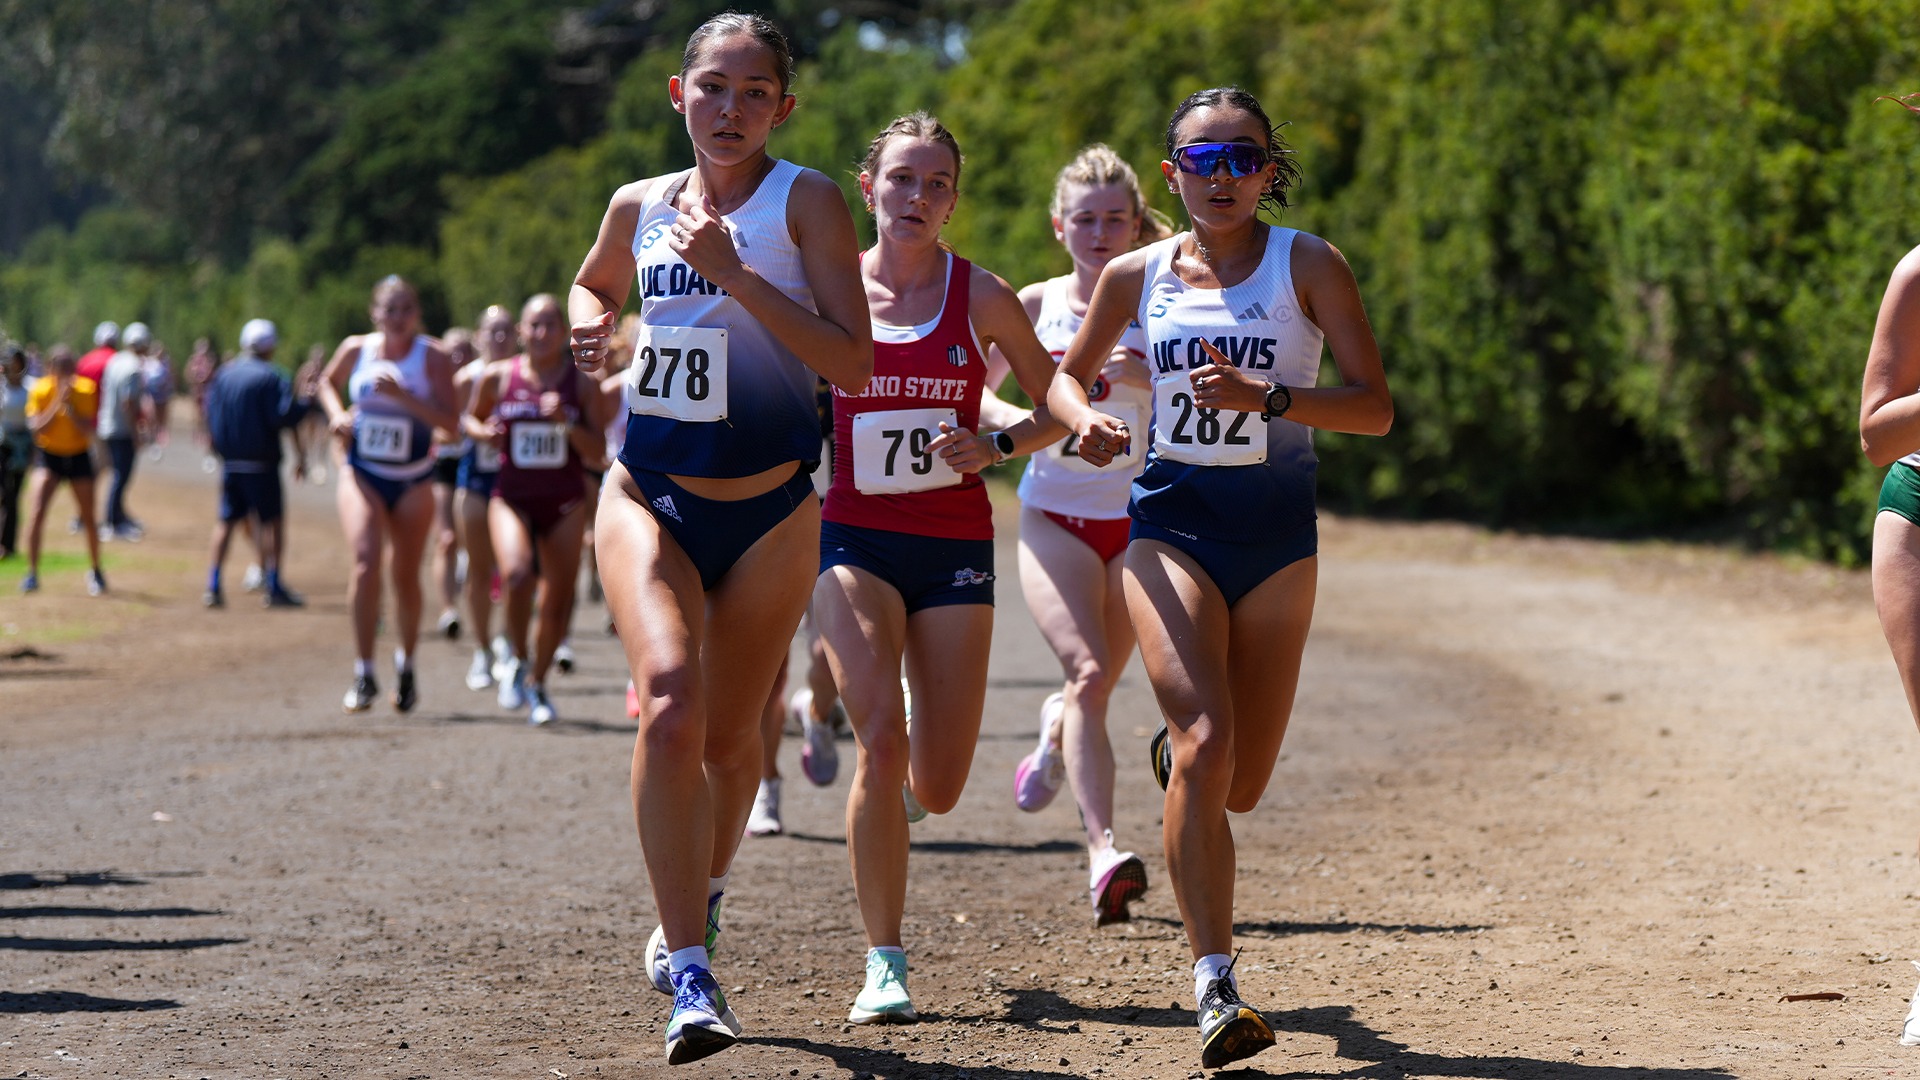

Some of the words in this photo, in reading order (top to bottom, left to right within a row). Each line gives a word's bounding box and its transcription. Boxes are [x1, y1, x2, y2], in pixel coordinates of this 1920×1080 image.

[641, 264, 665, 299] UC
[638, 346, 709, 401] 278
[1153, 338, 1182, 373] UC
[1187, 335, 1277, 370] DAVIS
[905, 377, 967, 401] STATE
[1171, 392, 1250, 445] 282
[882, 428, 933, 477] 79
